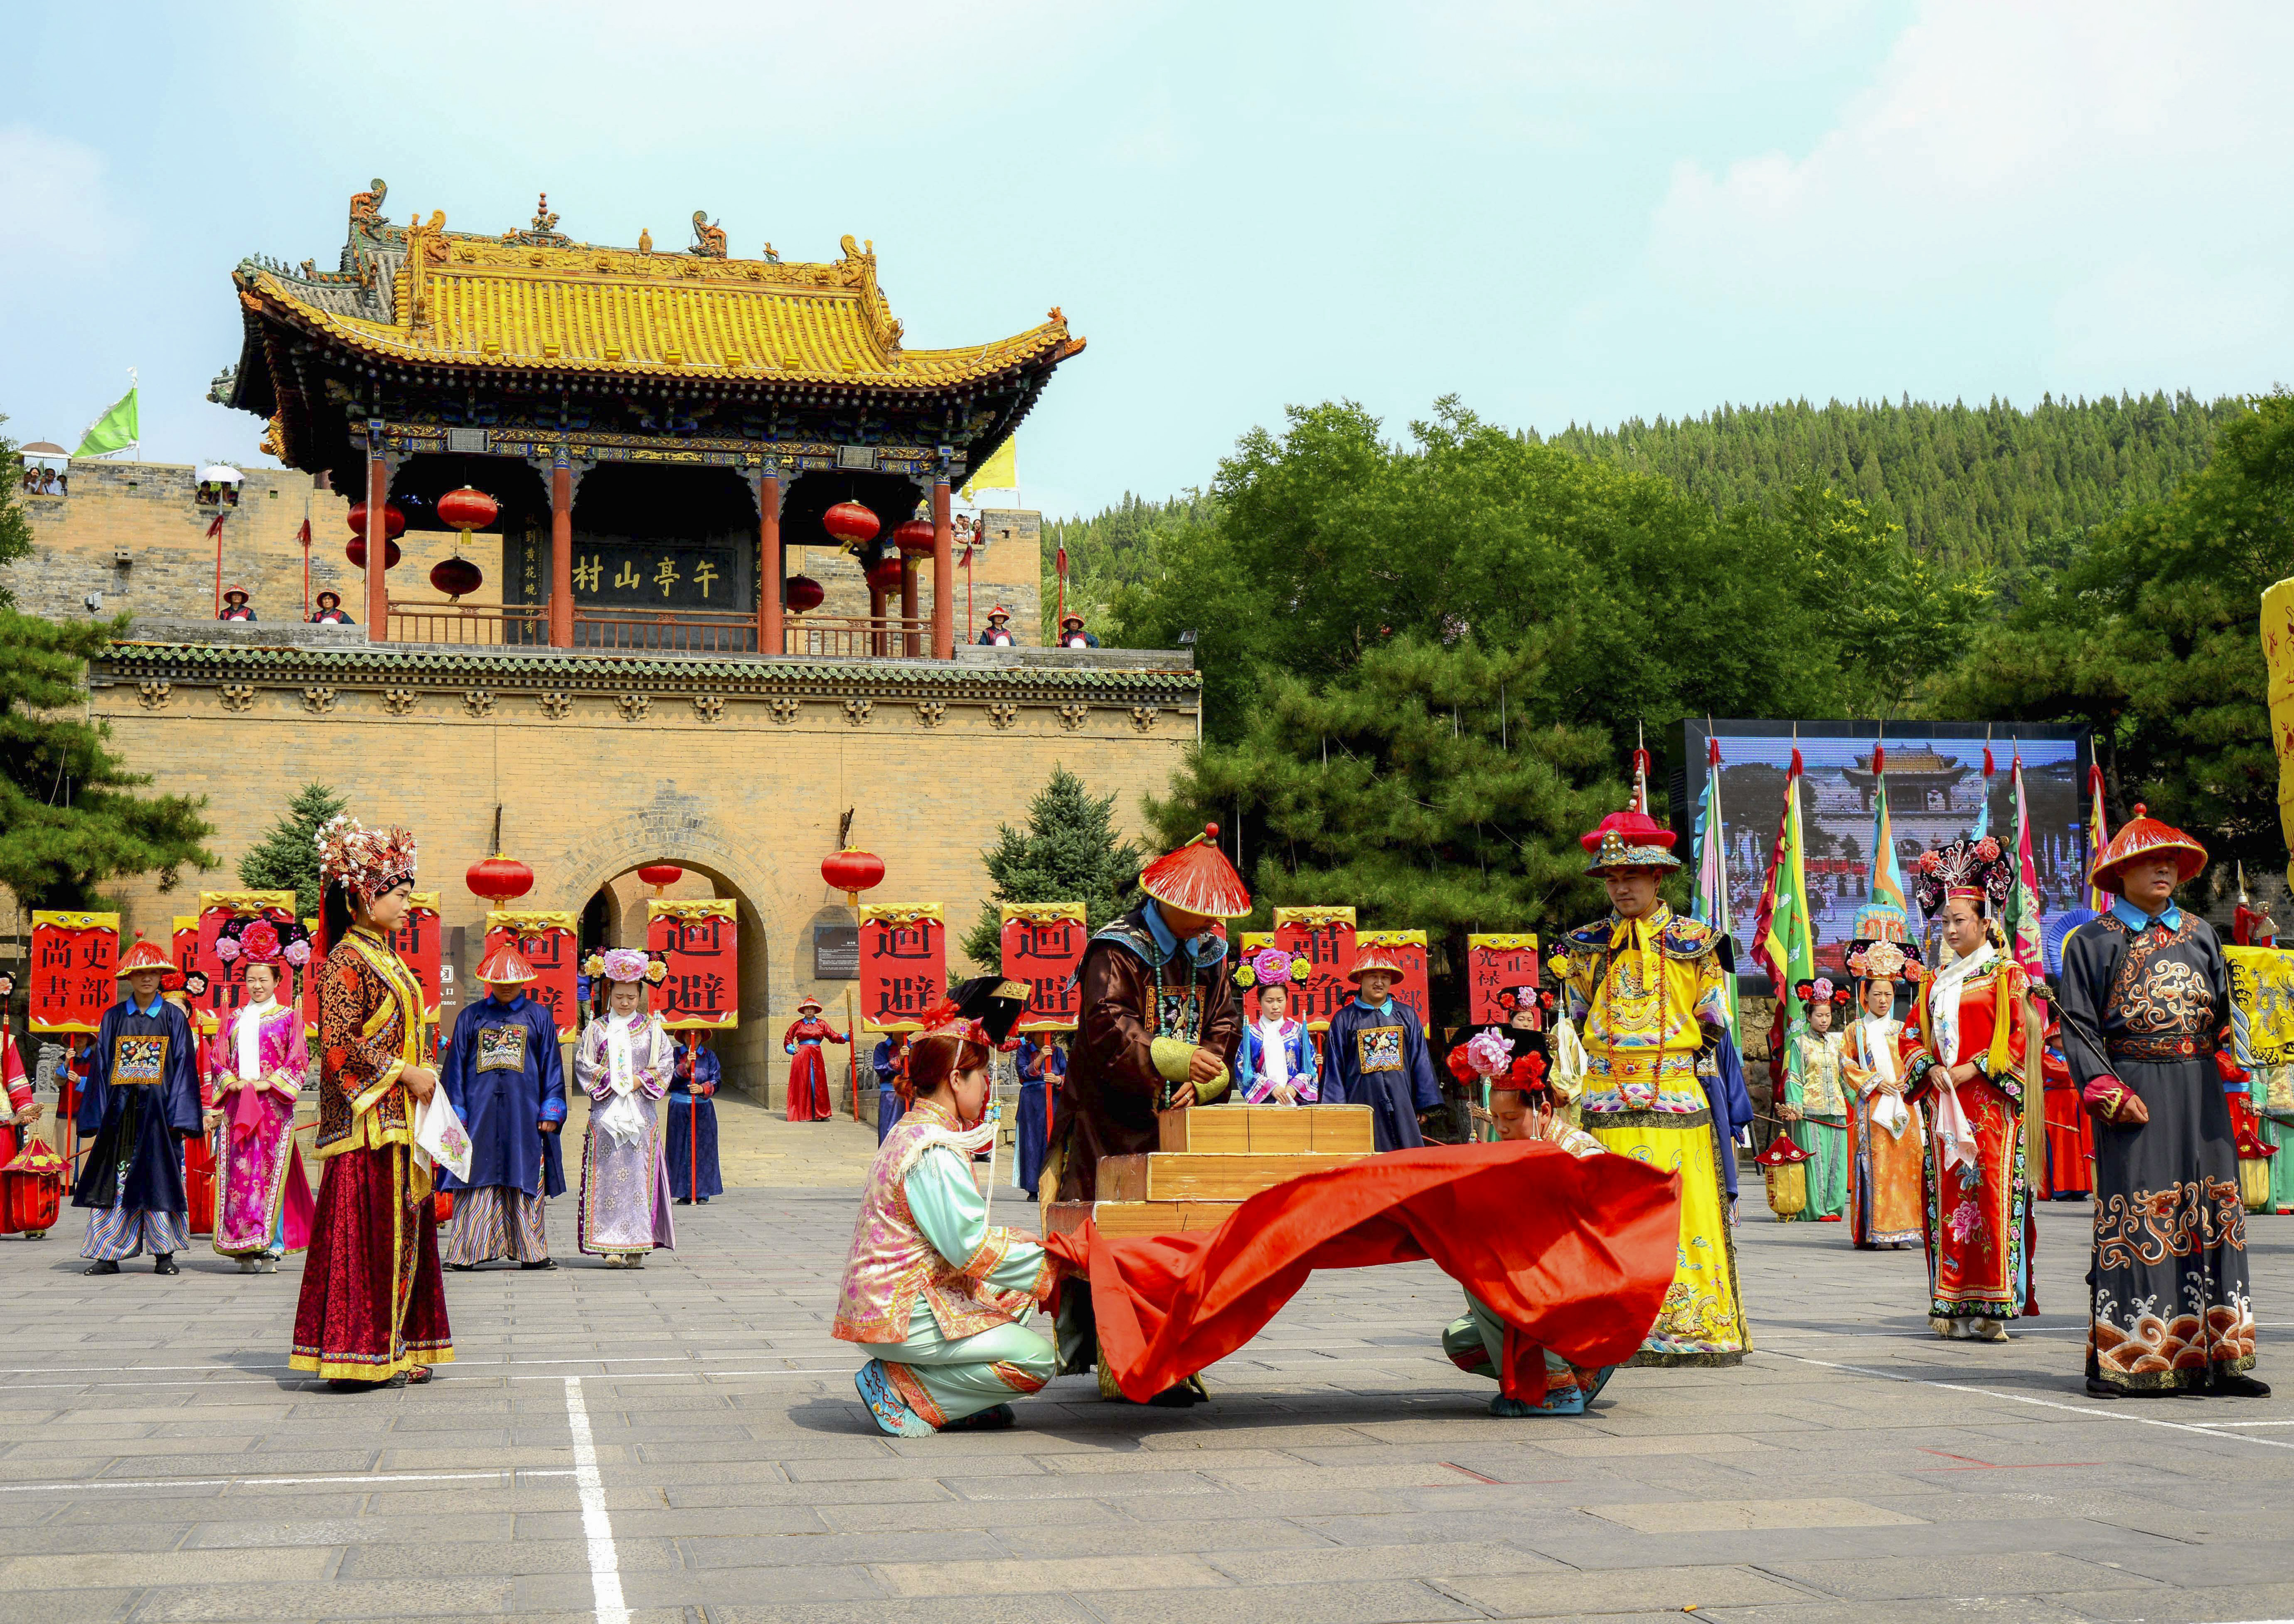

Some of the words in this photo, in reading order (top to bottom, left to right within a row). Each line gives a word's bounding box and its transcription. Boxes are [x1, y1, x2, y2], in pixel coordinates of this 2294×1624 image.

[572, 554, 719, 598] 午亭山村
[42, 938, 72, 1007] 尚書
[77, 939, 112, 1008] 吏部
